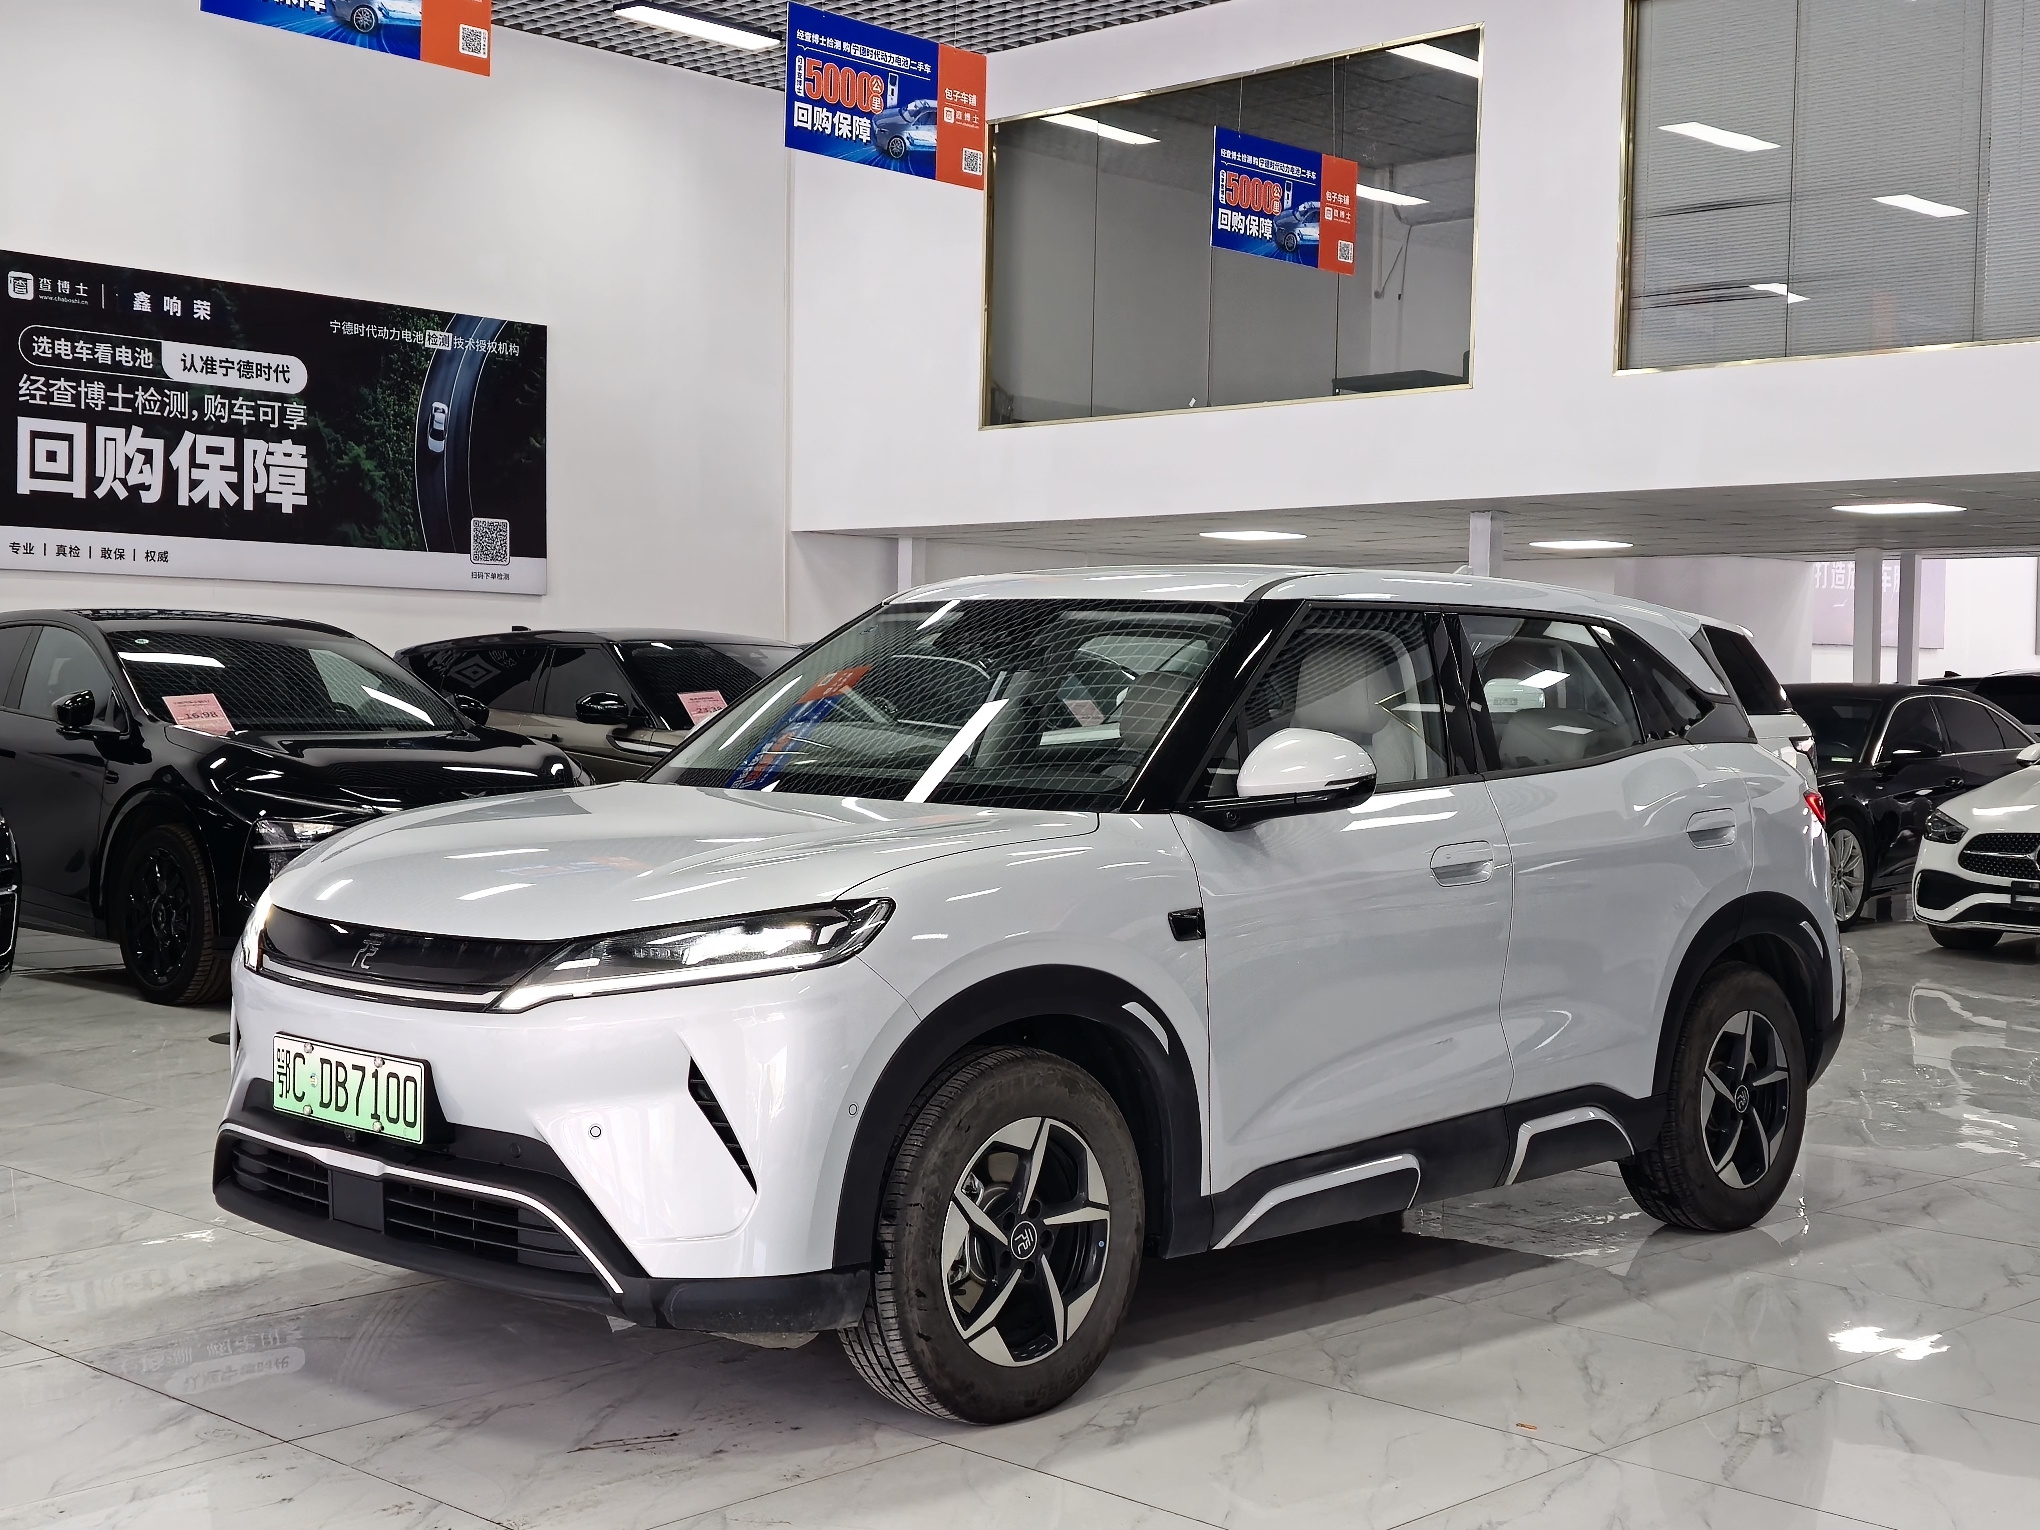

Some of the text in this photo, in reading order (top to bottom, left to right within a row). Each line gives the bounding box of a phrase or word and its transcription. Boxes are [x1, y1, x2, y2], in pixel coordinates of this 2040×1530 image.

[796, 29, 841, 50] 经查博士检测
[805, 57, 884, 112] 5000 公里
[944, 88, 976, 107] 包子车铺
[793, 101, 871, 143] 回购保障
[1226, 171, 1274, 215] 5000
[1272, 184, 1282, 213] 公里
[1217, 207, 1273, 240] 回购保障
[38, 277, 89, 297] 查博士
[132, 291, 212, 320] 鑫响荣
[38, 294, 89, 305] www.chaboshi.cn
[329, 319, 520, 357] 宁德时代动力电池检测技术授权机构
[32, 335, 291, 384] 选电车看电池 认准宁德时代
[16, 416, 308, 514] 回购保障
[9, 541, 170, 563] 专业 真检 敢保 权威
[471, 571, 510, 581] 扫码下单检测
[319, 1057, 418, 1129] DB7100
